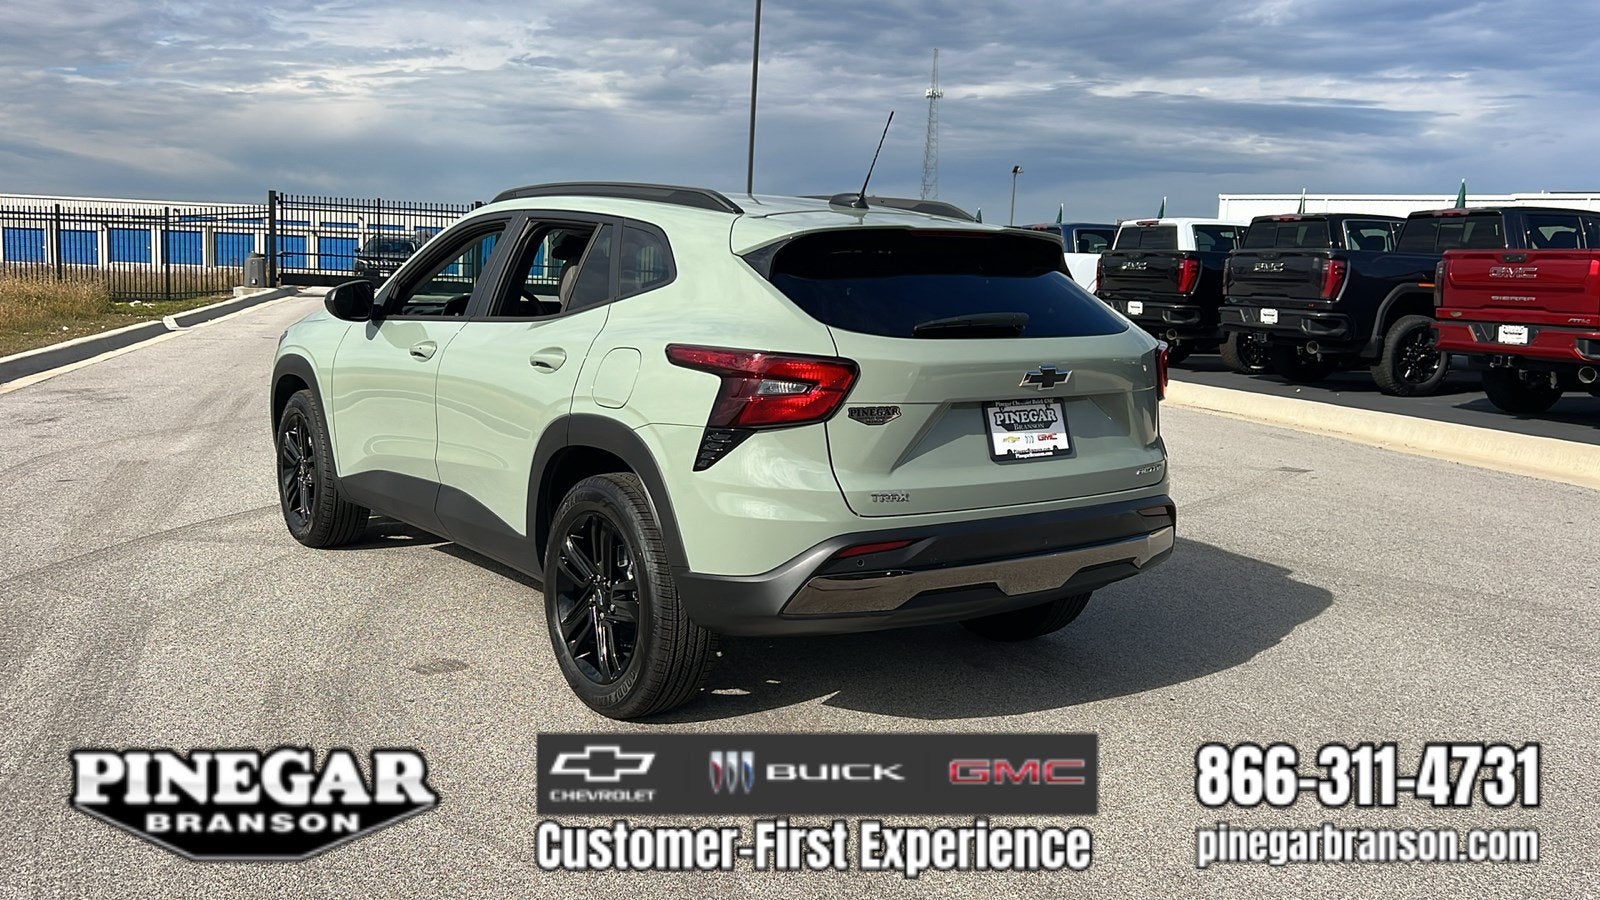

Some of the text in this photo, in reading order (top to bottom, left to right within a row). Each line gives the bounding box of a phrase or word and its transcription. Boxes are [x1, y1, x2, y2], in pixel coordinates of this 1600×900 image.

[1489, 266, 1538, 278] GMC
[848, 406, 900, 416] PINEGAR
[995, 409, 1057, 425] PINEGAR
[1037, 433, 1057, 441] GMC
[870, 492, 909, 503] TRAX
